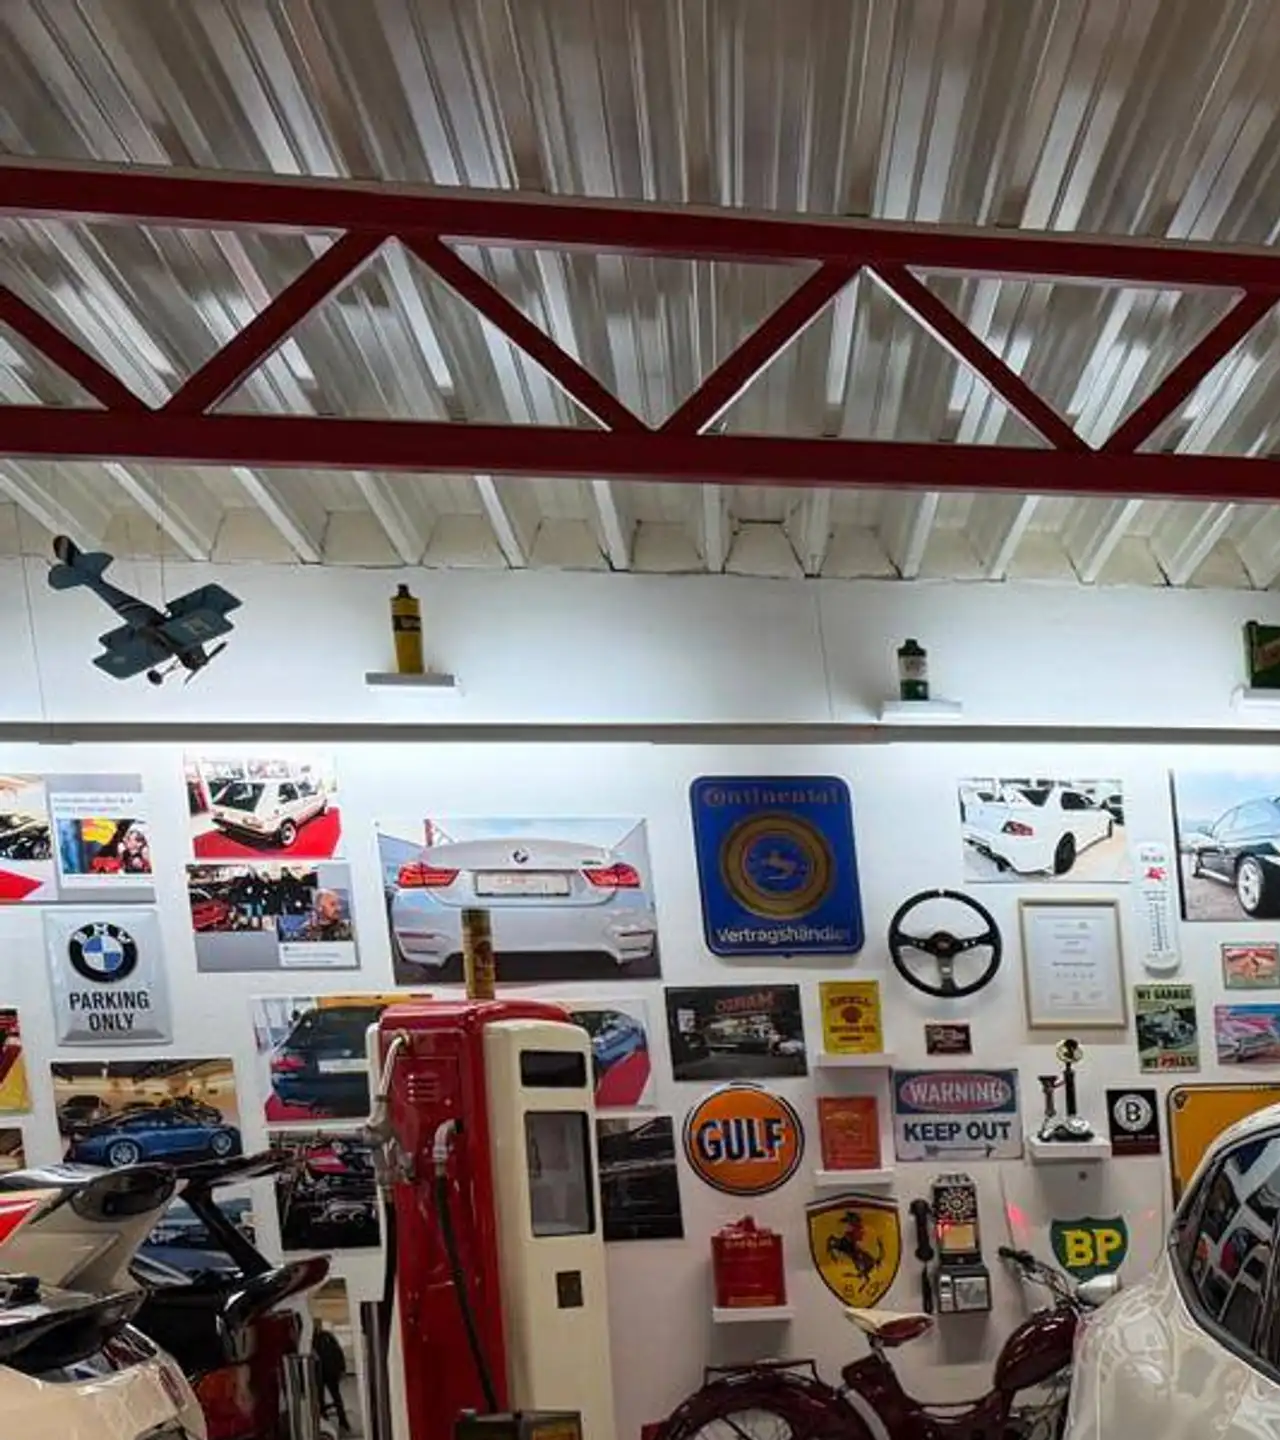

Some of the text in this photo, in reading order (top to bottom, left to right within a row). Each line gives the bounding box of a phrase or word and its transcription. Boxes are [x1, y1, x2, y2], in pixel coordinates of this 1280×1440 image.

[69, 990, 150, 1010] PARKING
[88, 1012, 135, 1031] ONLY
[909, 1080, 1003, 1102] WARNING
[697, 1118, 785, 1163] GULF
[904, 1121, 1012, 1142] KEEP OUT
[1061, 1227, 1122, 1268] BP
